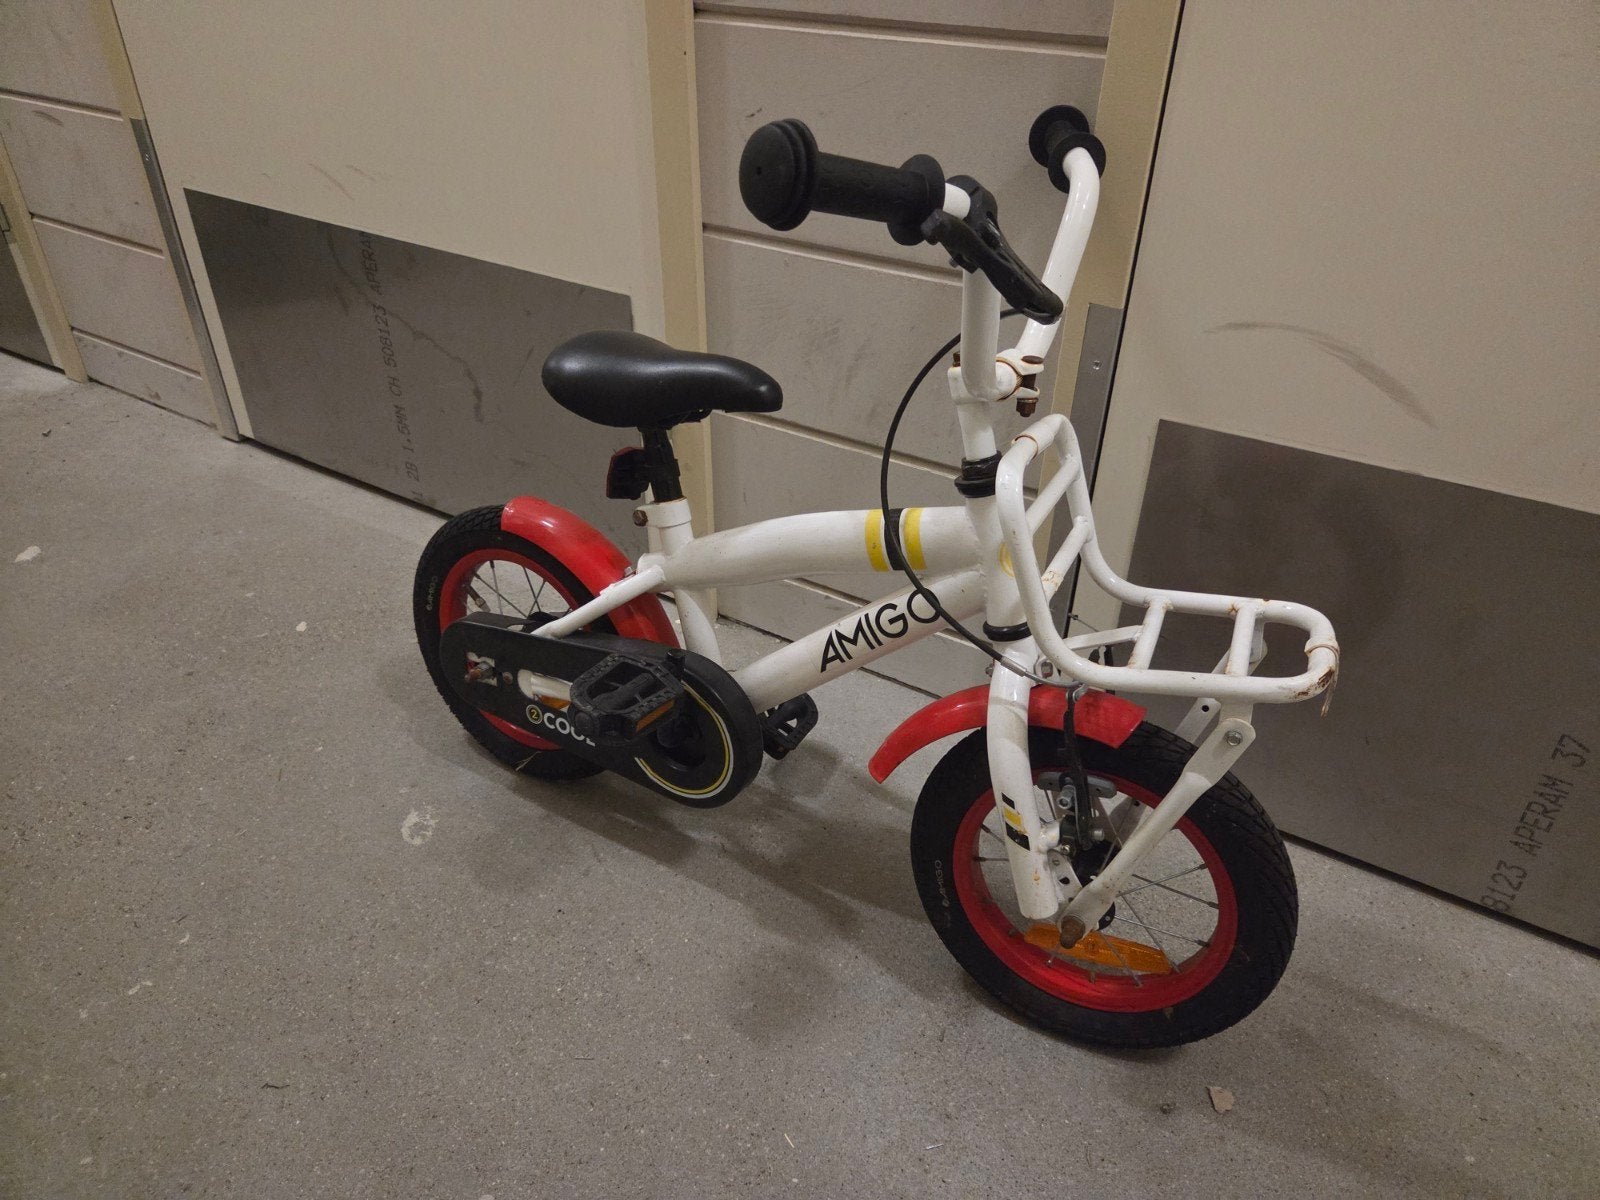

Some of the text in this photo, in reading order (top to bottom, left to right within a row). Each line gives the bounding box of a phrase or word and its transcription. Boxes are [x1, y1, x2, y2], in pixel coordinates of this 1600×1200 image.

[372, 303, 397, 368] 508123
[387, 376, 402, 397] CH
[405, 461, 419, 481] 2B
[821, 588, 941, 673] AMIGO
[1509, 774, 1574, 857] APERAM
[1552, 734, 1590, 768] 37
